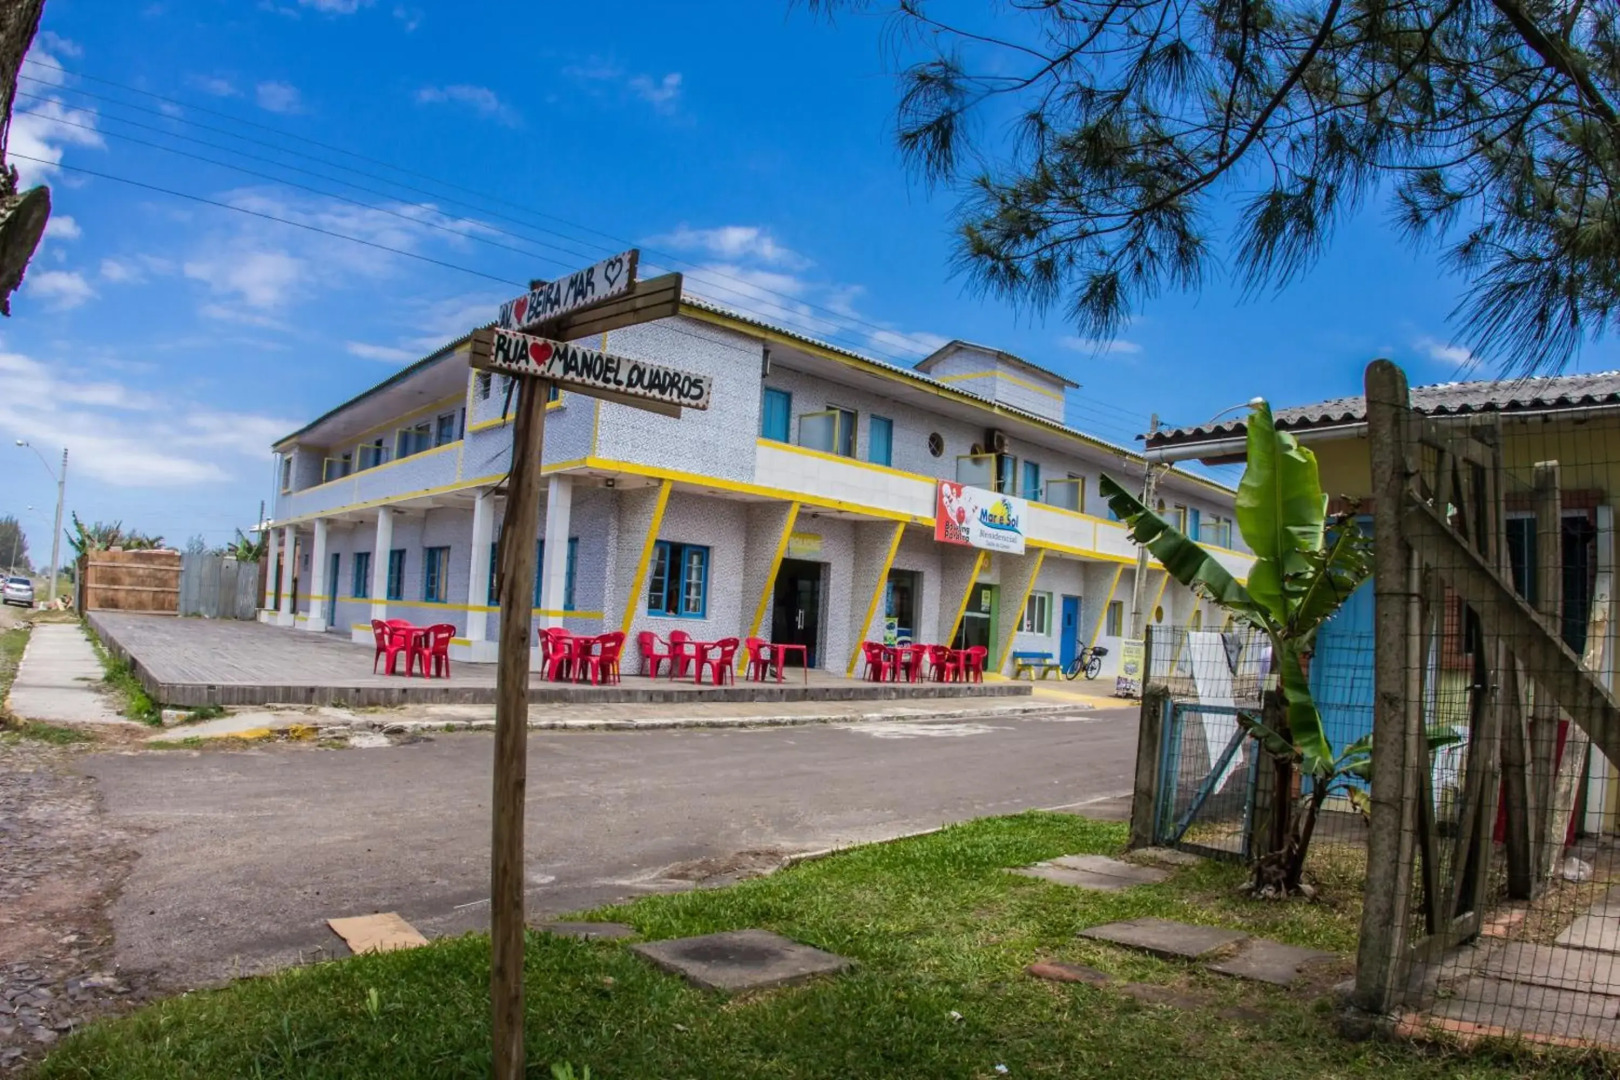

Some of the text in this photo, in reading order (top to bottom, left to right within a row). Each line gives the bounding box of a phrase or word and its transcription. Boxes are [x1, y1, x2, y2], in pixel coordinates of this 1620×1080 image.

[527, 280, 561, 322] BEIRA
[564, 267, 595, 307] MAR
[495, 334, 705, 400] RUA MANOEL QUADROS
[980, 508, 1019, 527] Mar e Sol
[945, 521, 970, 535] Bowling
[979, 529, 1018, 543] Residencial
